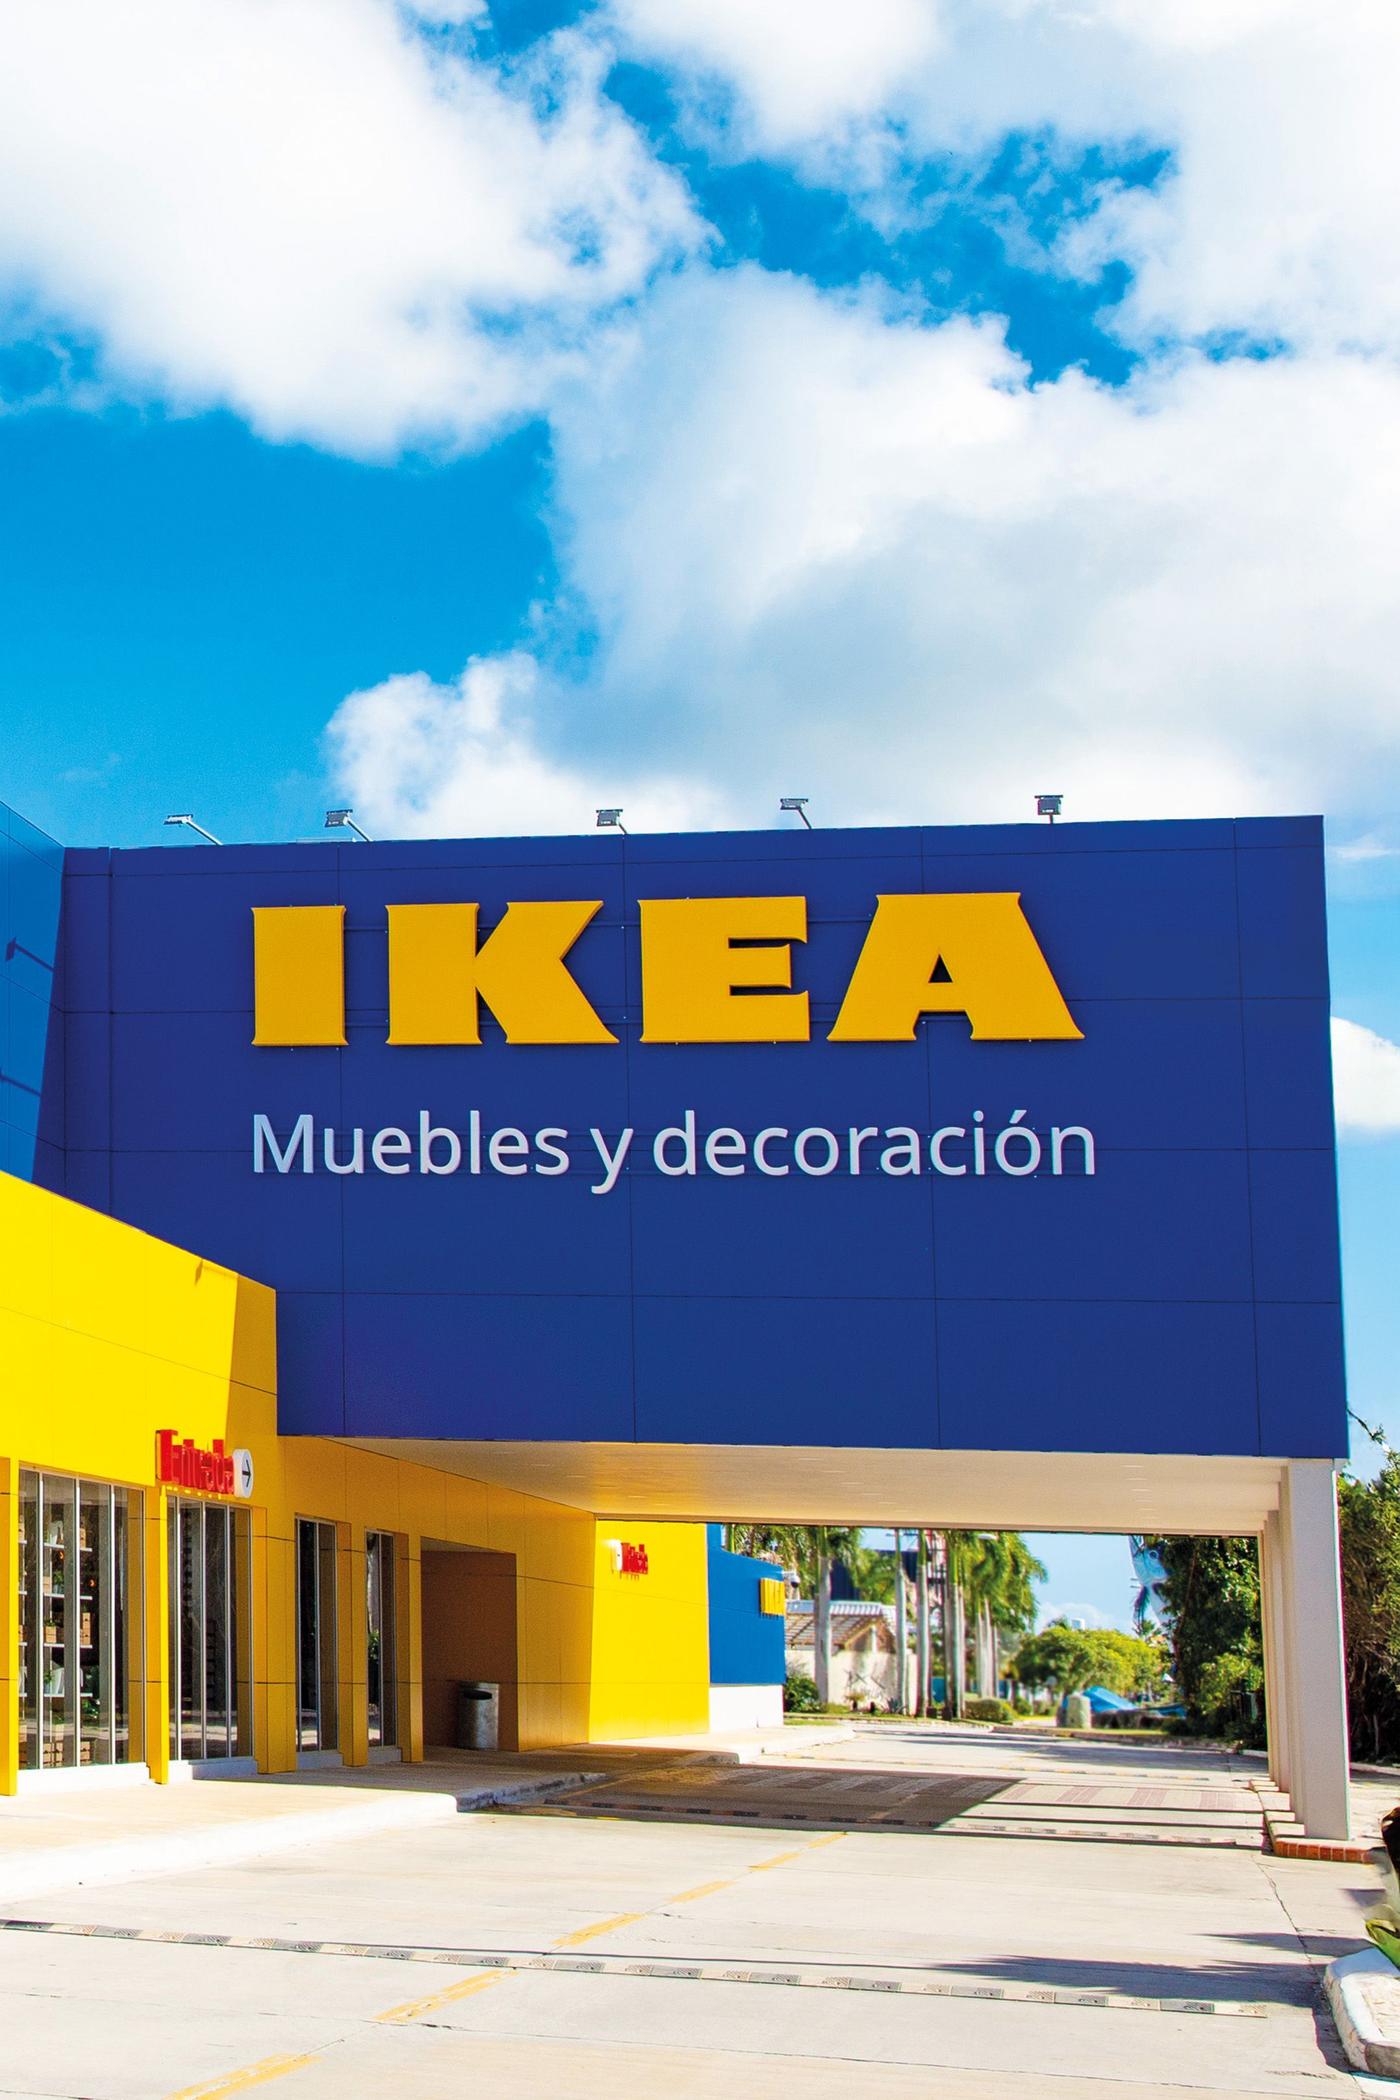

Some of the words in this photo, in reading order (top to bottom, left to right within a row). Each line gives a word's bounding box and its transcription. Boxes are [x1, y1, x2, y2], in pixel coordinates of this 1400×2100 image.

[252, 892, 1084, 1046] IKEA
[253, 1110, 571, 1176] Muebles
[590, 1128, 634, 1195] y
[652, 1109, 1096, 1177] decoración
